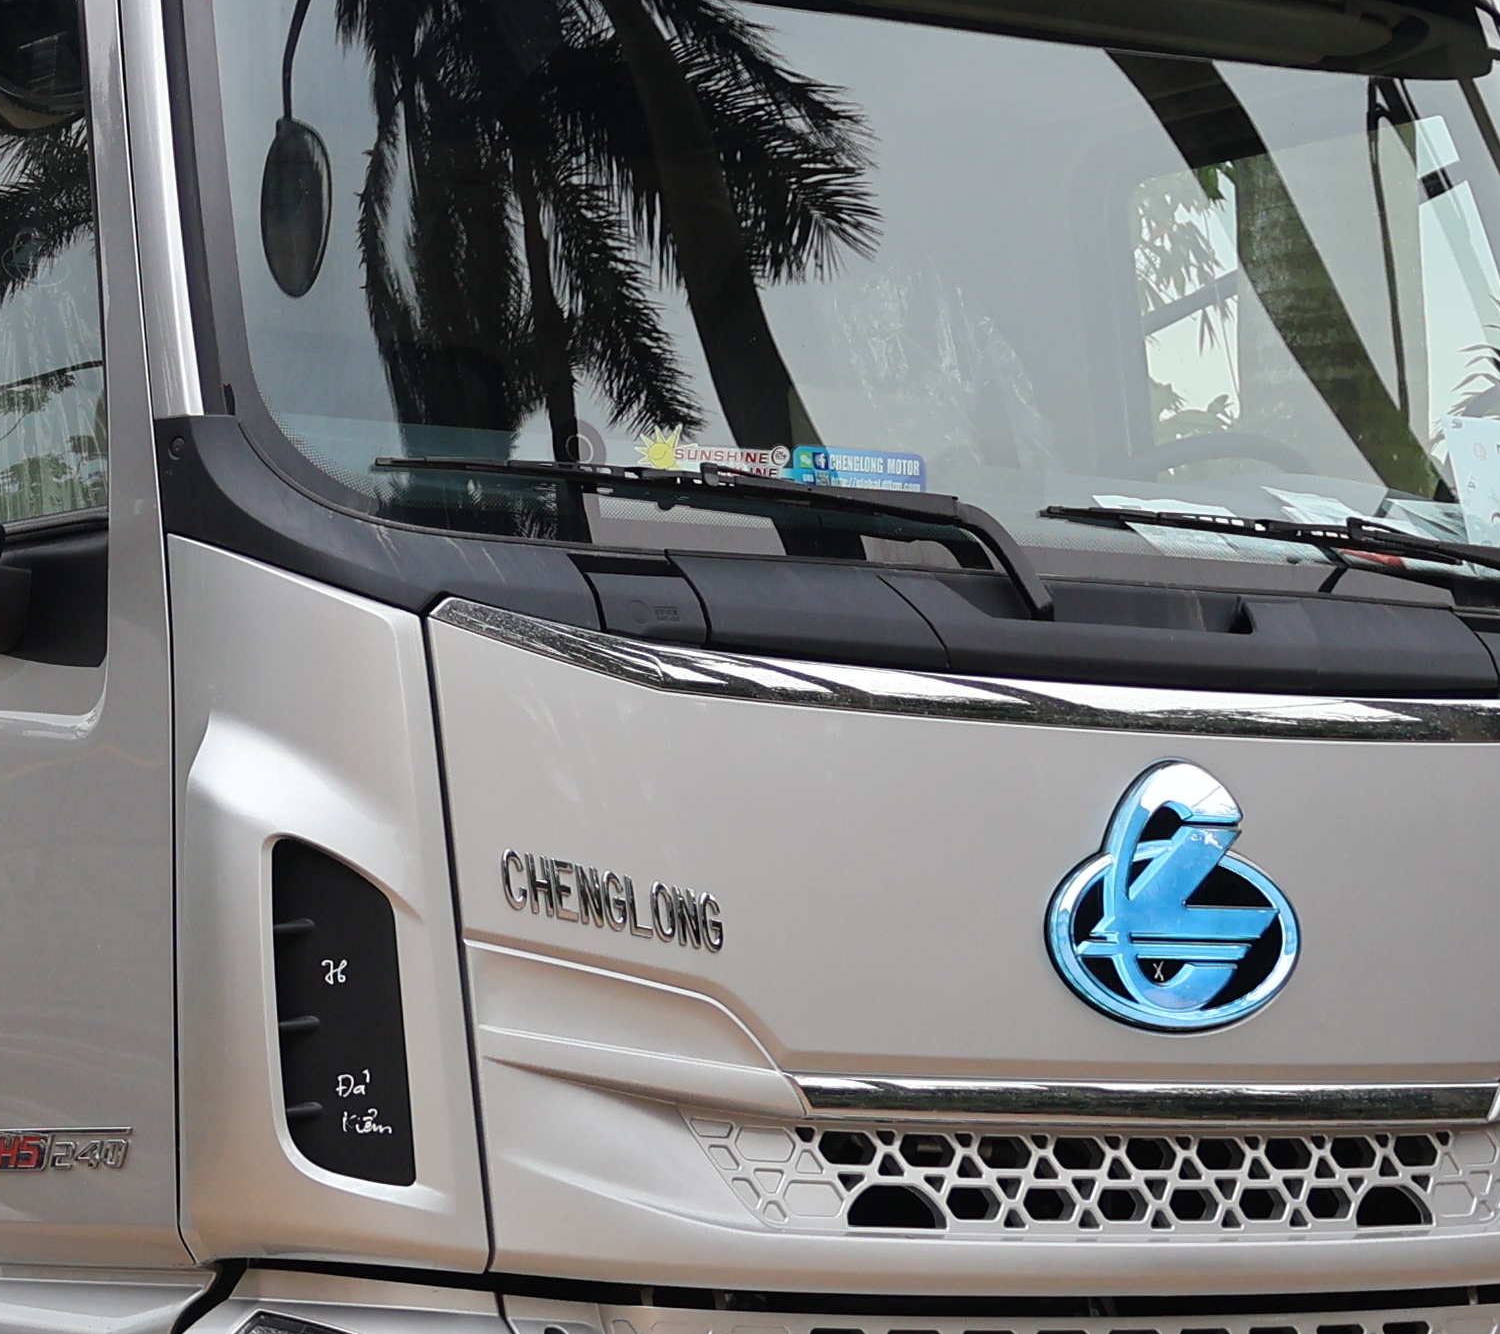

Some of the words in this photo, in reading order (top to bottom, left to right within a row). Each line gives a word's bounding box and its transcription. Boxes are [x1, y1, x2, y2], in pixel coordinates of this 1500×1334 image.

[673, 448, 769, 464] SUNSHINE
[829, 453, 884, 474] CHENGLONG
[887, 457, 920, 476] MOTOR
[501, 847, 724, 953] CHENGLONG
[51, 1139, 128, 1170] 240
